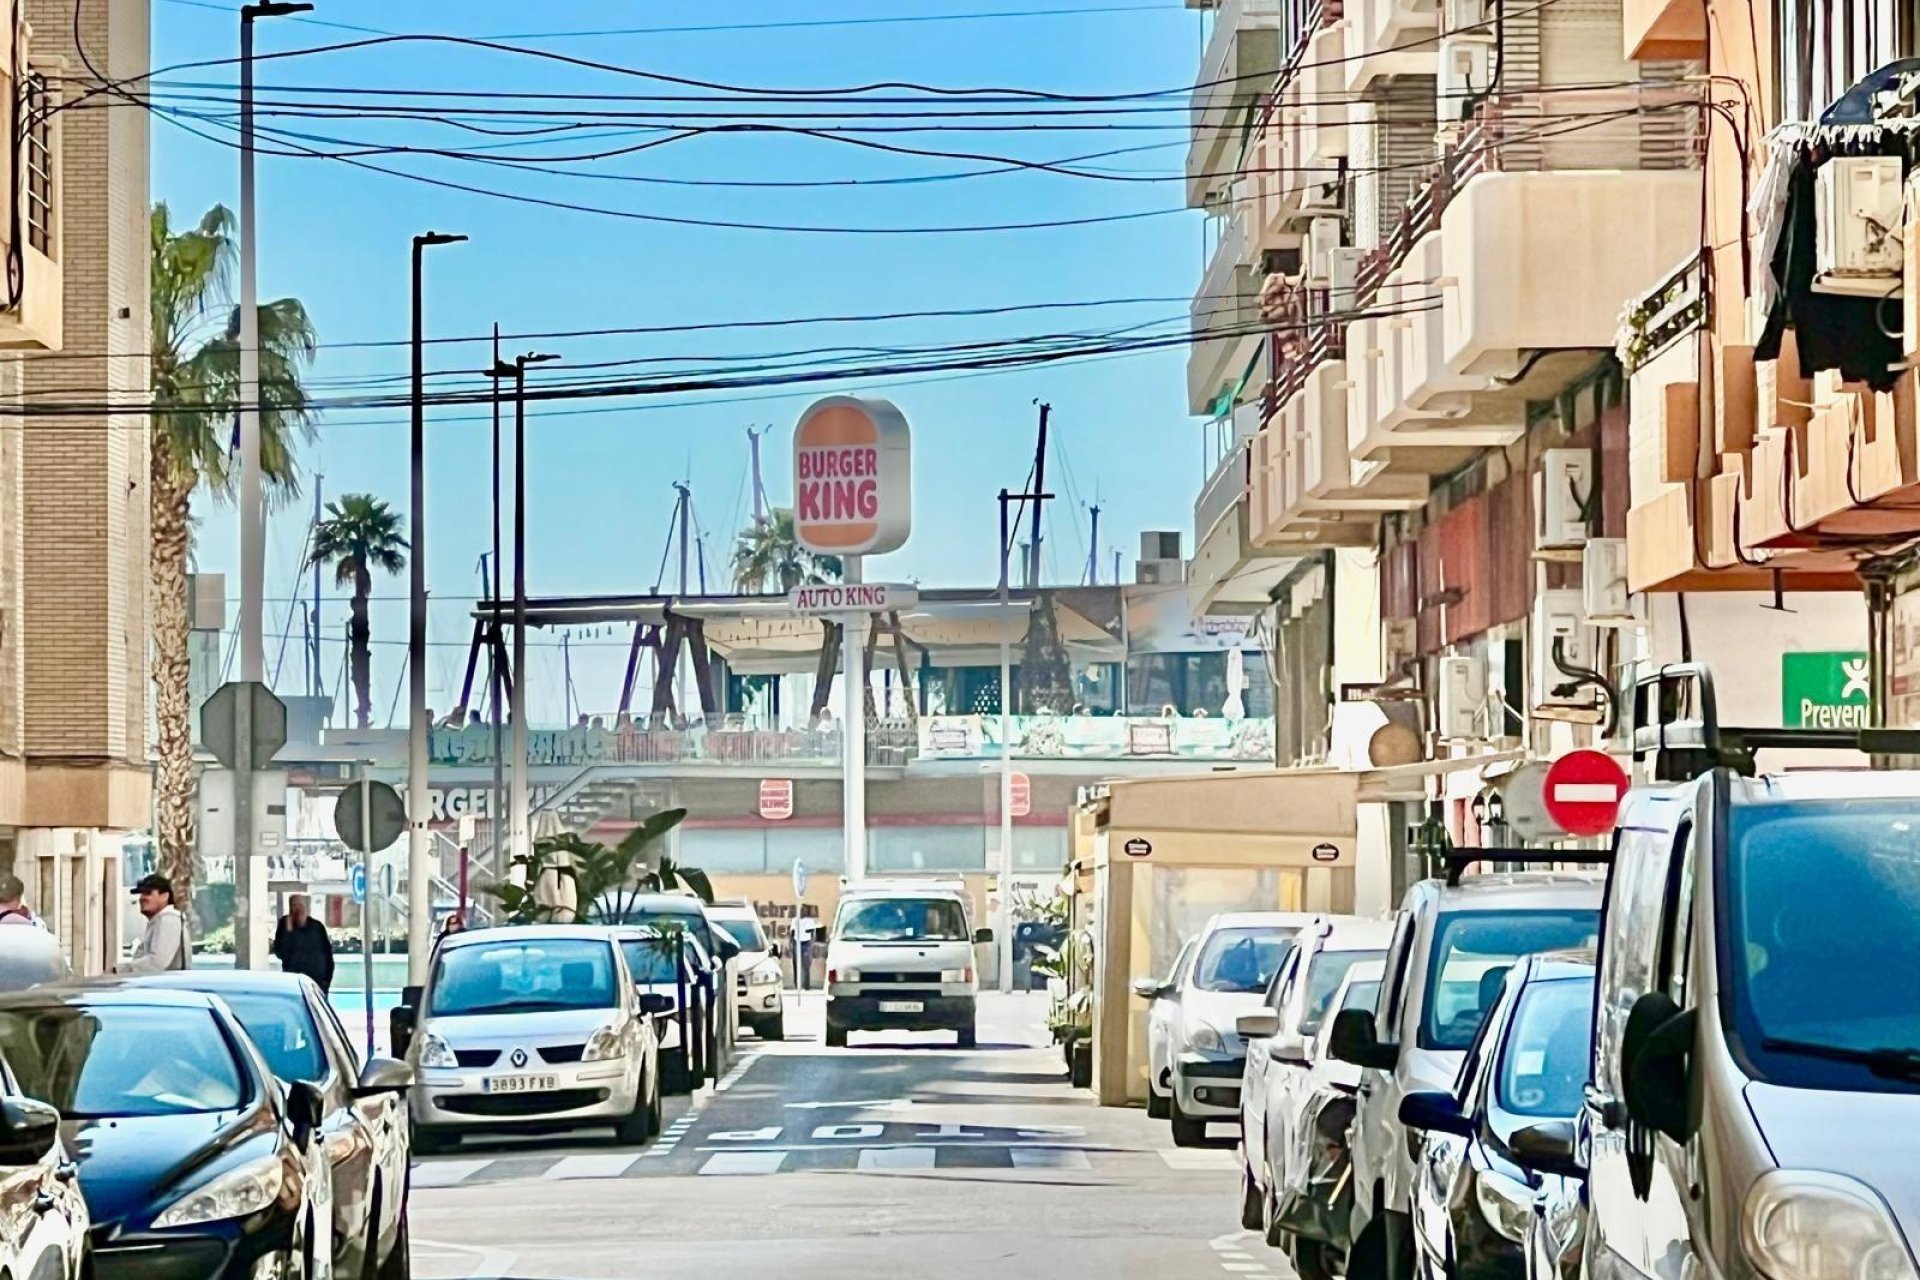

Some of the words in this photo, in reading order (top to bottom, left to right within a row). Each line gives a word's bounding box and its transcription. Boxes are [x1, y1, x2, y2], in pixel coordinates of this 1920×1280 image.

[799, 449, 877, 479] BURGER
[799, 480, 878, 520] KING
[797, 587, 842, 608] AUTO
[845, 586, 886, 606] KING
